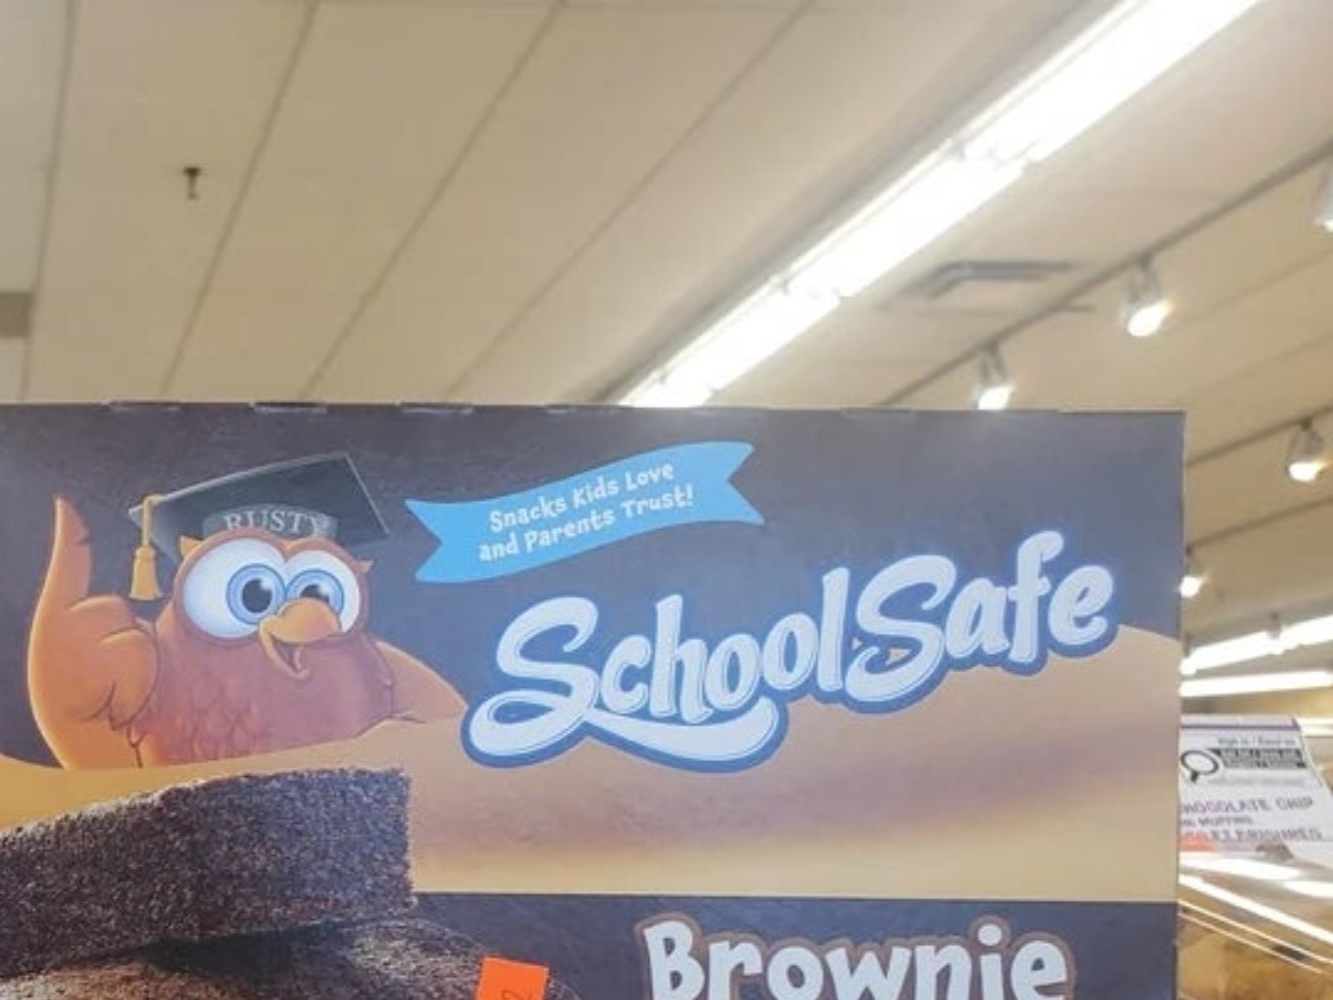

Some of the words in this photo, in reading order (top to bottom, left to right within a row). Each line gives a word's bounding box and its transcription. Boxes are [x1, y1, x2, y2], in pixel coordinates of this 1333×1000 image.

[224, 510, 329, 537] RUSTY
[478, 533, 519, 563] and
[524, 508, 615, 554] Parents
[620, 483, 694, 520] Trust!
[488, 496, 568, 534] Snacks
[572, 475, 619, 508] Kids
[624, 462, 675, 492] Love
[465, 528, 1117, 767] SchoolSafe
